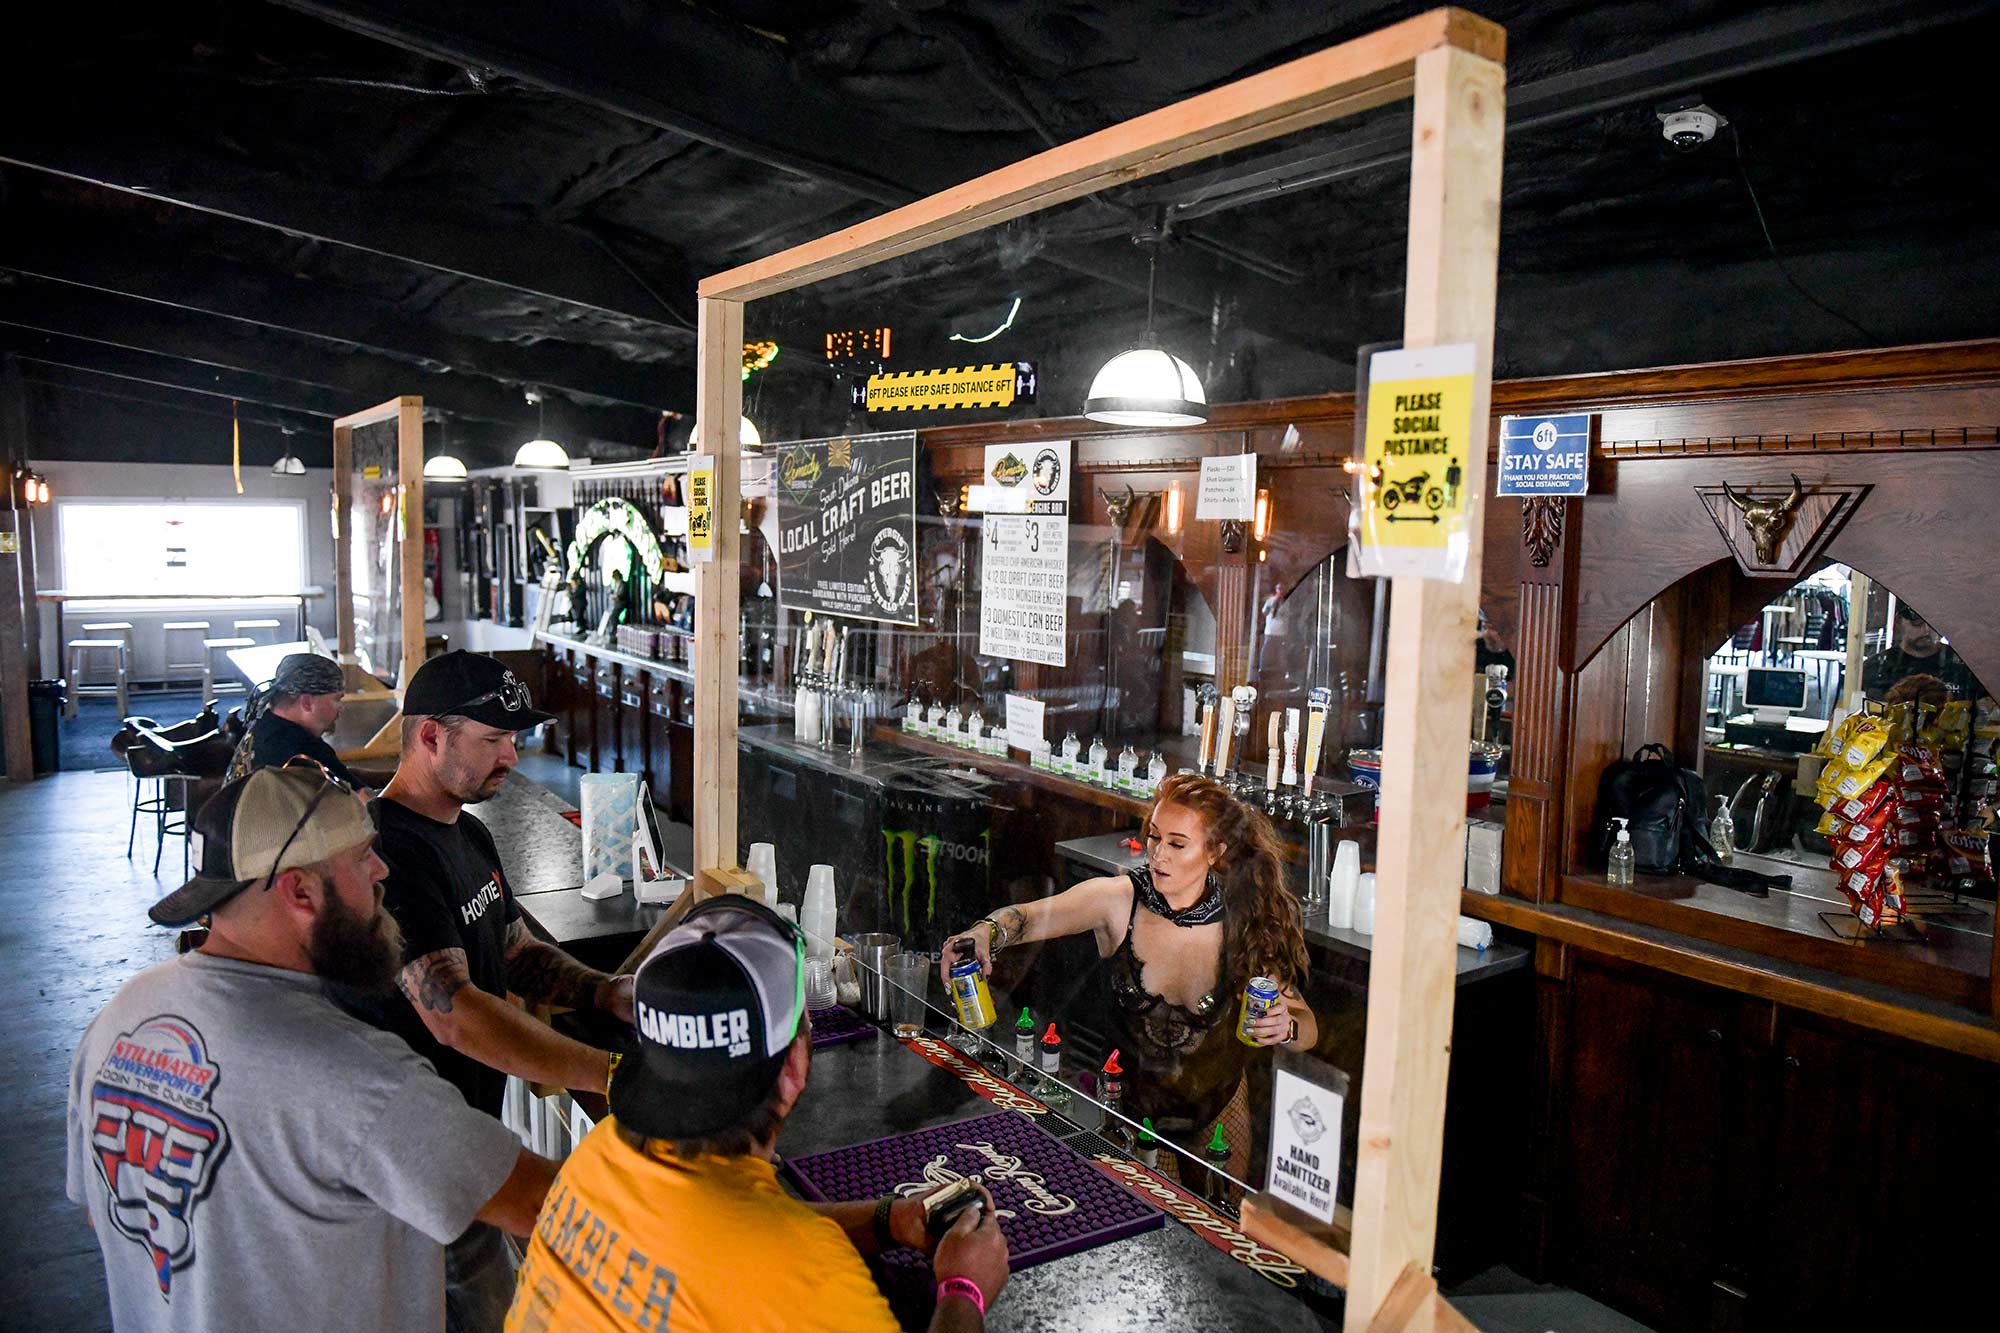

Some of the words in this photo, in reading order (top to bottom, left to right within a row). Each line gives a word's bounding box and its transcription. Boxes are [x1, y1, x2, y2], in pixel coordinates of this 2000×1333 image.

[869, 388, 881, 399] 6FT
[883, 386, 908, 399] PLEASE
[910, 385, 929, 397] KEEP
[930, 383, 950, 395] SAFE
[952, 381, 993, 394] DISTANCE
[995, 379, 1012, 392] 6FT
[1395, 392, 1443, 412] PLEASE
[1393, 415, 1440, 435] SOCIAL
[1536, 429, 1553, 443] 6ft
[1384, 437, 1448, 456] DISTANCE
[1504, 454, 1542, 471] STAY
[1545, 453, 1584, 469] SAFE
[694, 477, 706, 486] PLEASE
[1535, 480, 1570, 488] DISTANCING
[780, 520, 819, 554] LOCAL
[822, 487, 866, 537] CRAFT
[871, 471, 911, 508] BEER
[821, 535, 837, 563] Sold
[873, 527, 905, 547] STURGIS
[868, 570, 898, 612] BUFFALO
[1008, 571, 1027, 586] DRAFT
[1028, 572, 1047, 588] CRAFT
[1048, 573, 1065, 589] BEER
[1015, 588, 1041, 604] MONSTER
[1042, 591, 1064, 606] ENERGY
[993, 608, 1027, 628] DOMESTIC
[1028, 612, 1043, 629] CAN
[1045, 614, 1064, 632] BEER
[1004, 628, 1020, 642] DRINK
[1031, 631, 1045, 645] CALL
[1046, 633, 1064, 648] DRINK
[637, 1000, 751, 1050] GAMBLER
[728, 1040, 751, 1059] 500
[114, 1041, 213, 1088] STILLWATER
[108, 1056, 204, 1098] POWERSPORTS
[916, 1036, 1048, 1123] Budweiser
[134, 1077, 160, 1096] THE
[162, 1087, 205, 1113] DUNES
[956, 1140, 1047, 1187] Royal
[1290, 1144, 1320, 1170] HAND
[1273, 1173, 1308, 1202] Available
[1276, 1156, 1332, 1195] SANITIZER
[1092, 1152, 1306, 1288] Budweiser
